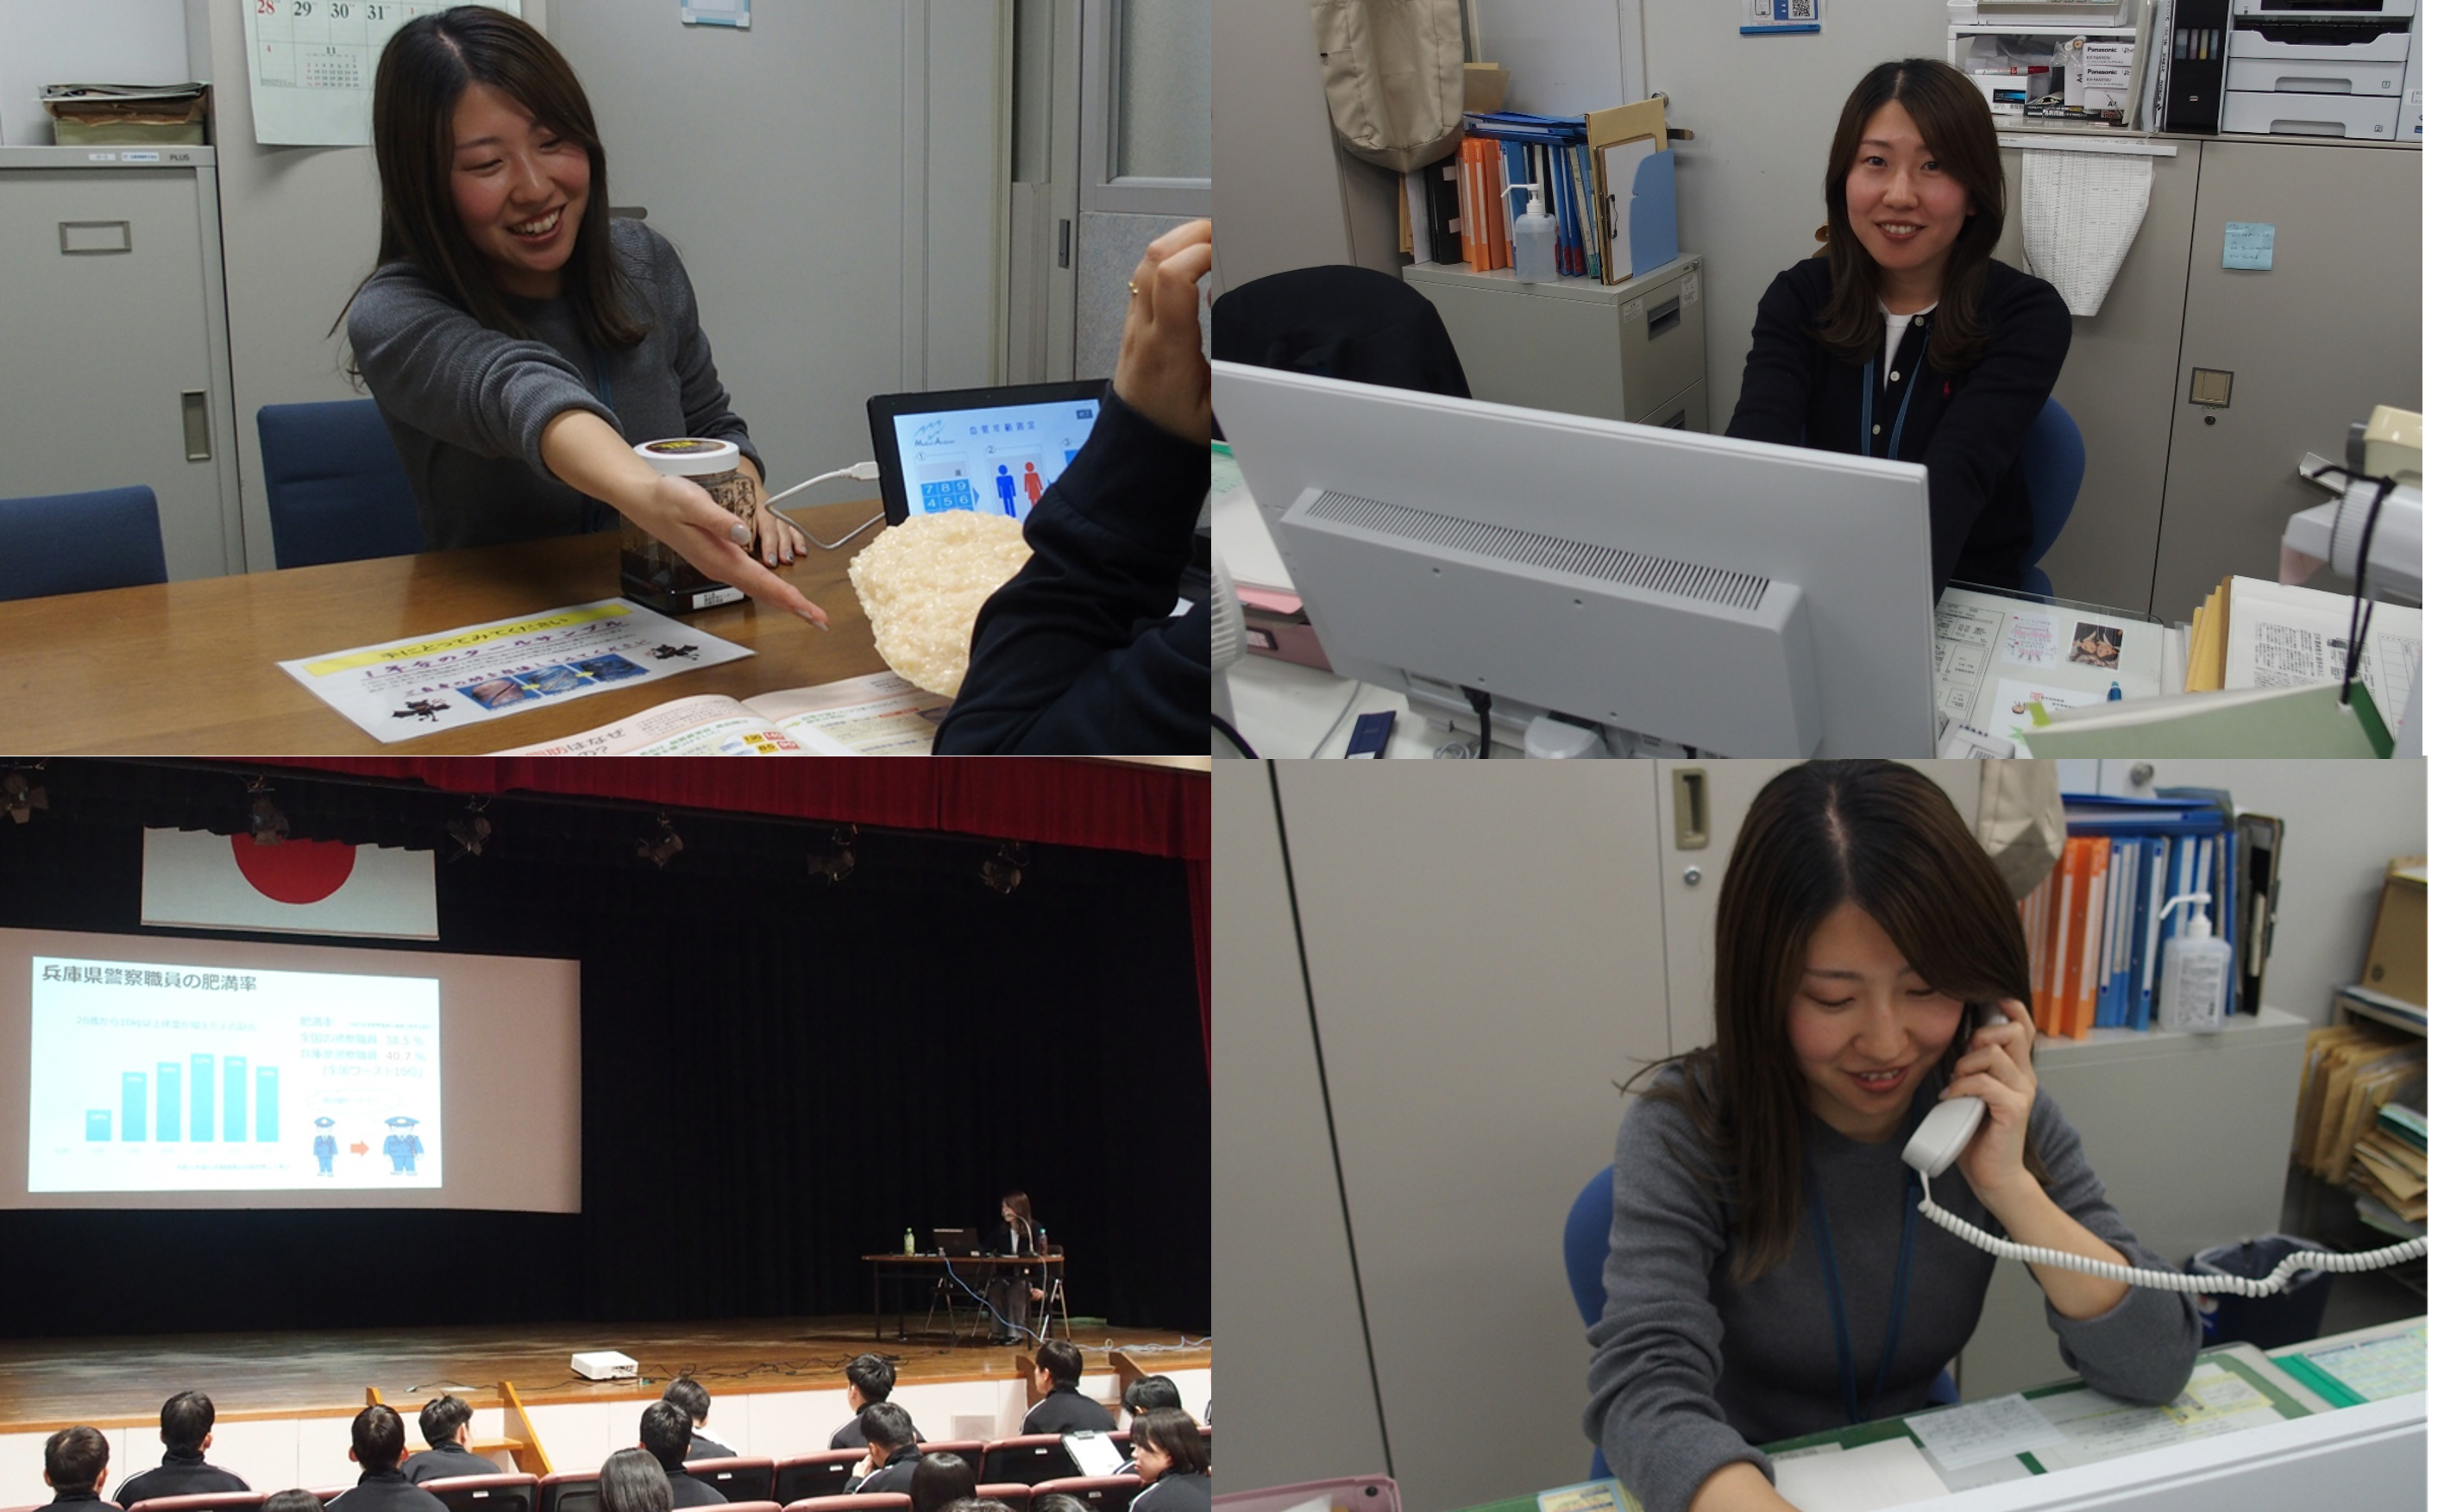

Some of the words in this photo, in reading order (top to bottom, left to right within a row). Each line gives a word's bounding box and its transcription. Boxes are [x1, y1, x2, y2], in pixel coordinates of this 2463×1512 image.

[258, 0, 275, 14] 28
[294, 2, 311, 16] 29
[331, 3, 349, 18] 30
[368, 5, 384, 20] 31
[925, 485, 933, 493] 7
[941, 483, 950, 492] 8
[957, 481, 965, 491] 9
[927, 499, 936, 508] 4
[943, 497, 952, 506] 5
[958, 495, 968, 505] 6
[42, 964, 258, 992] 兵庫県警察職員の肥満率
[386, 1051, 412, 1061] 40.7
